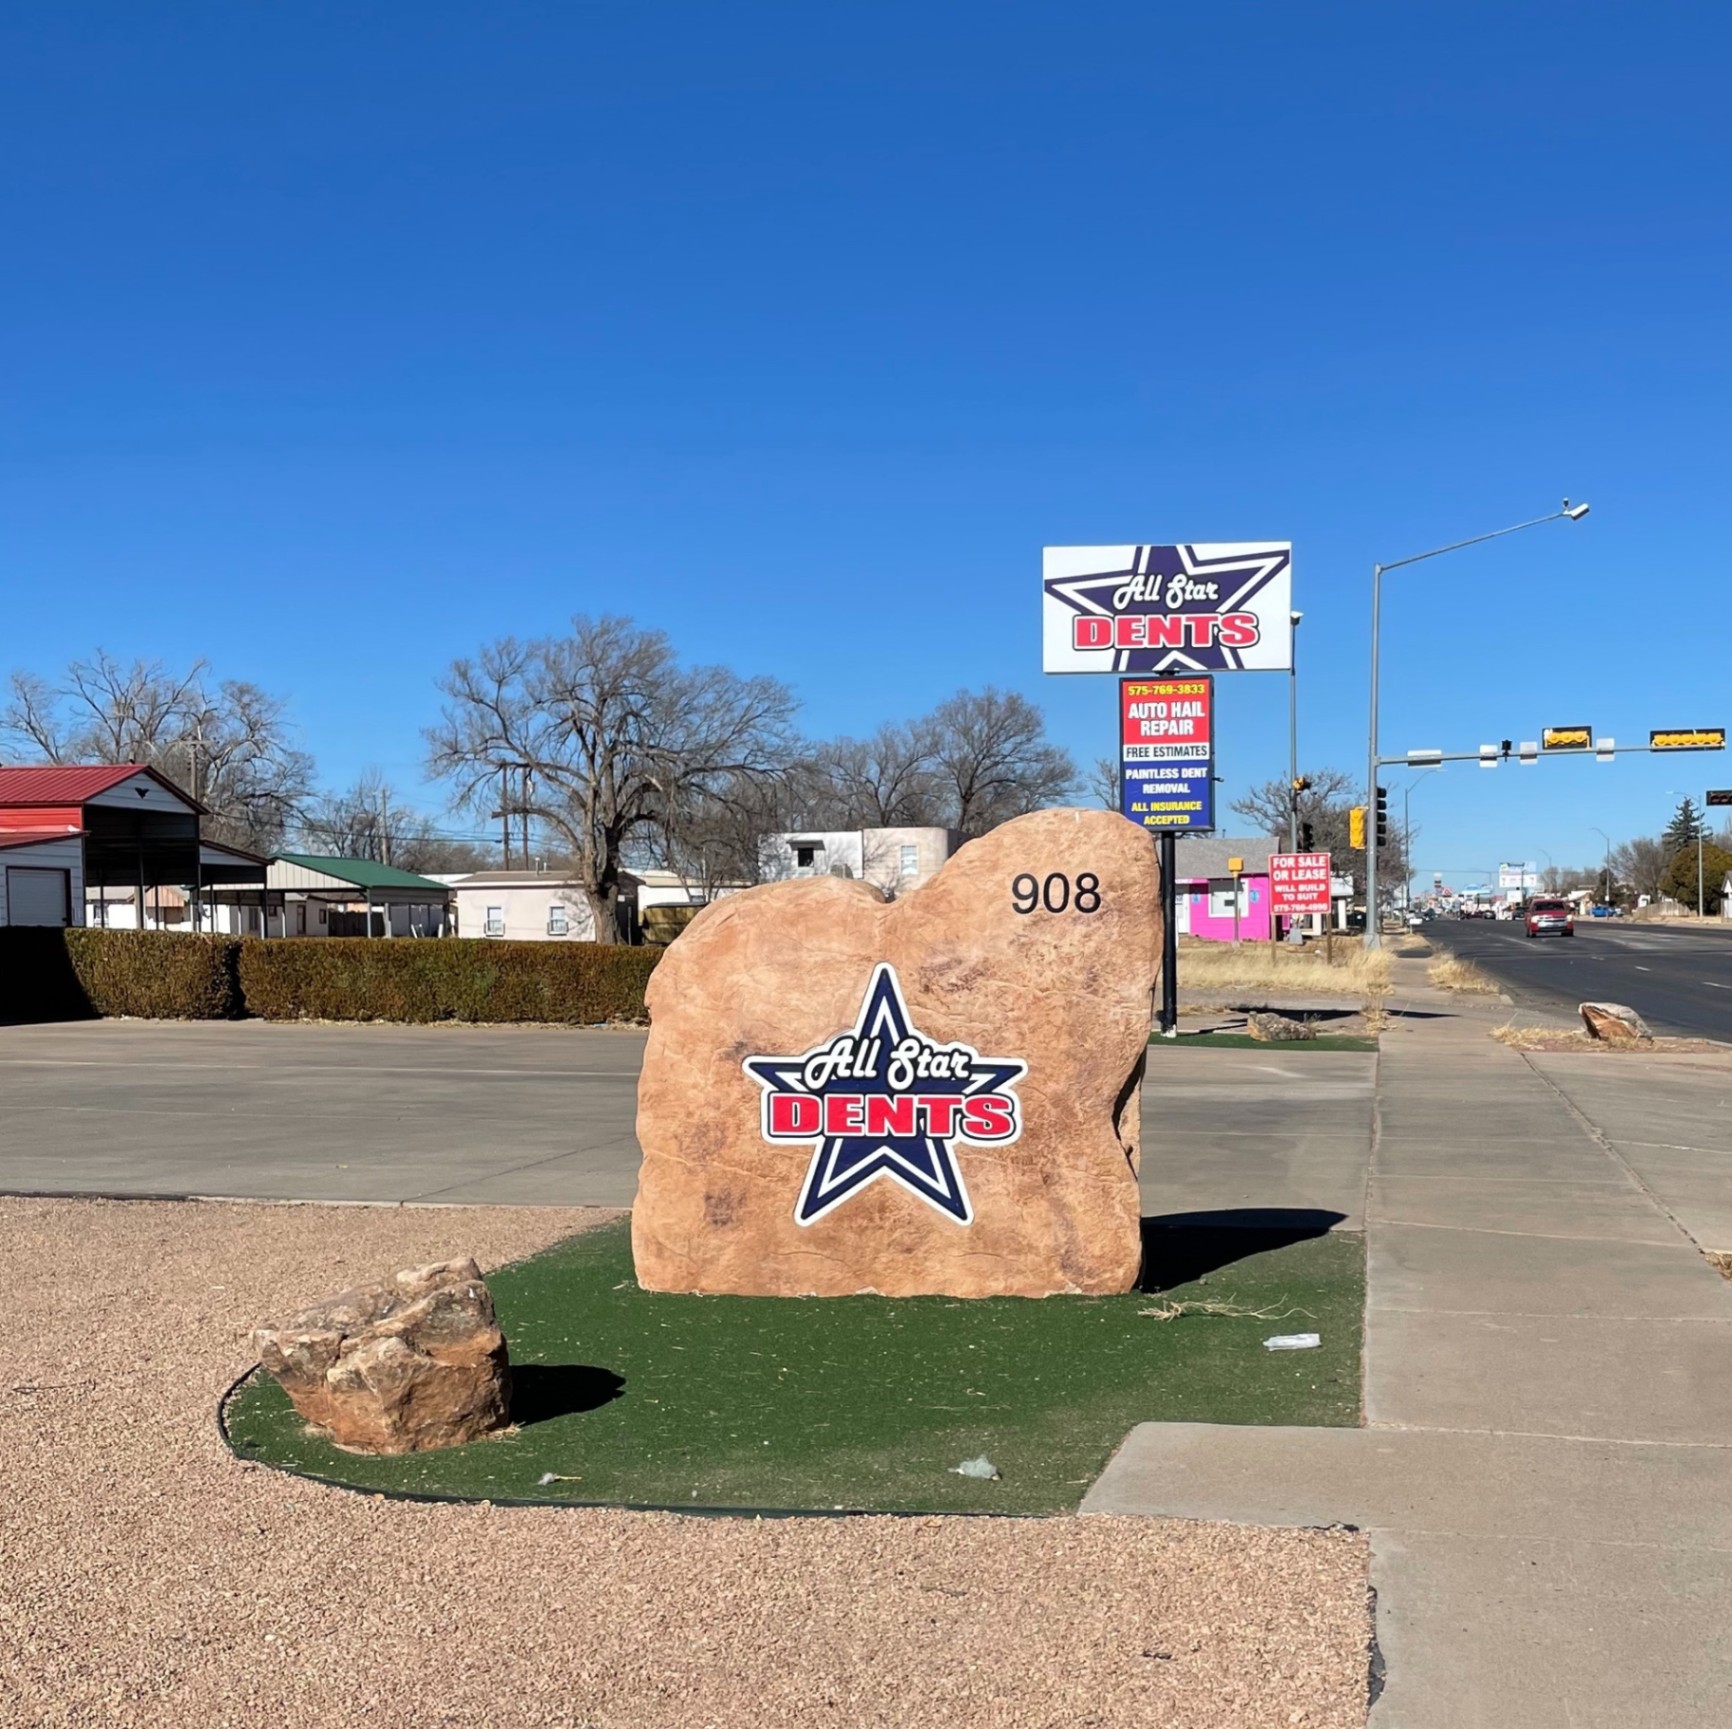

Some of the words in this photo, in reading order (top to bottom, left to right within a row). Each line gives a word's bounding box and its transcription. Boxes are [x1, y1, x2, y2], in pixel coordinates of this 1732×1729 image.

[1113, 574, 1162, 609] All
[1165, 573, 1219, 609] Star
[1074, 613, 1259, 649] DENTS
[1128, 684, 1205, 695] 575-769-3833
[1128, 702, 1167, 718] AUTO
[1171, 702, 1205, 718] HAIL
[1141, 719, 1194, 736] REPAIR
[1126, 746, 1150, 758] FREE
[1153, 745, 1208, 758] ESTIMATES
[1125, 768, 1179, 780] PAINTLESS
[1181, 767, 1208, 778] DENT
[1142, 783, 1191, 794] REMOVAL
[1131, 802, 1149, 811] ALL
[1151, 801, 1203, 811] INSURANCE
[1143, 815, 1190, 825] ACCEPTED
[1273, 857, 1295, 868] FOR
[1297, 856, 1326, 867] SALE
[1273, 870, 1289, 881] OR
[1292, 869, 1326, 880] LEASE
[1011, 872, 1102, 915] 908
[1298, 884, 1326, 892] BUILD
[1282, 893, 1295, 901] TO
[1297, 892, 1318, 900] SUIT
[807, 1038, 879, 1090] All
[887, 1038, 970, 1090] Star
[768, 1093, 1014, 1139] DENTS
